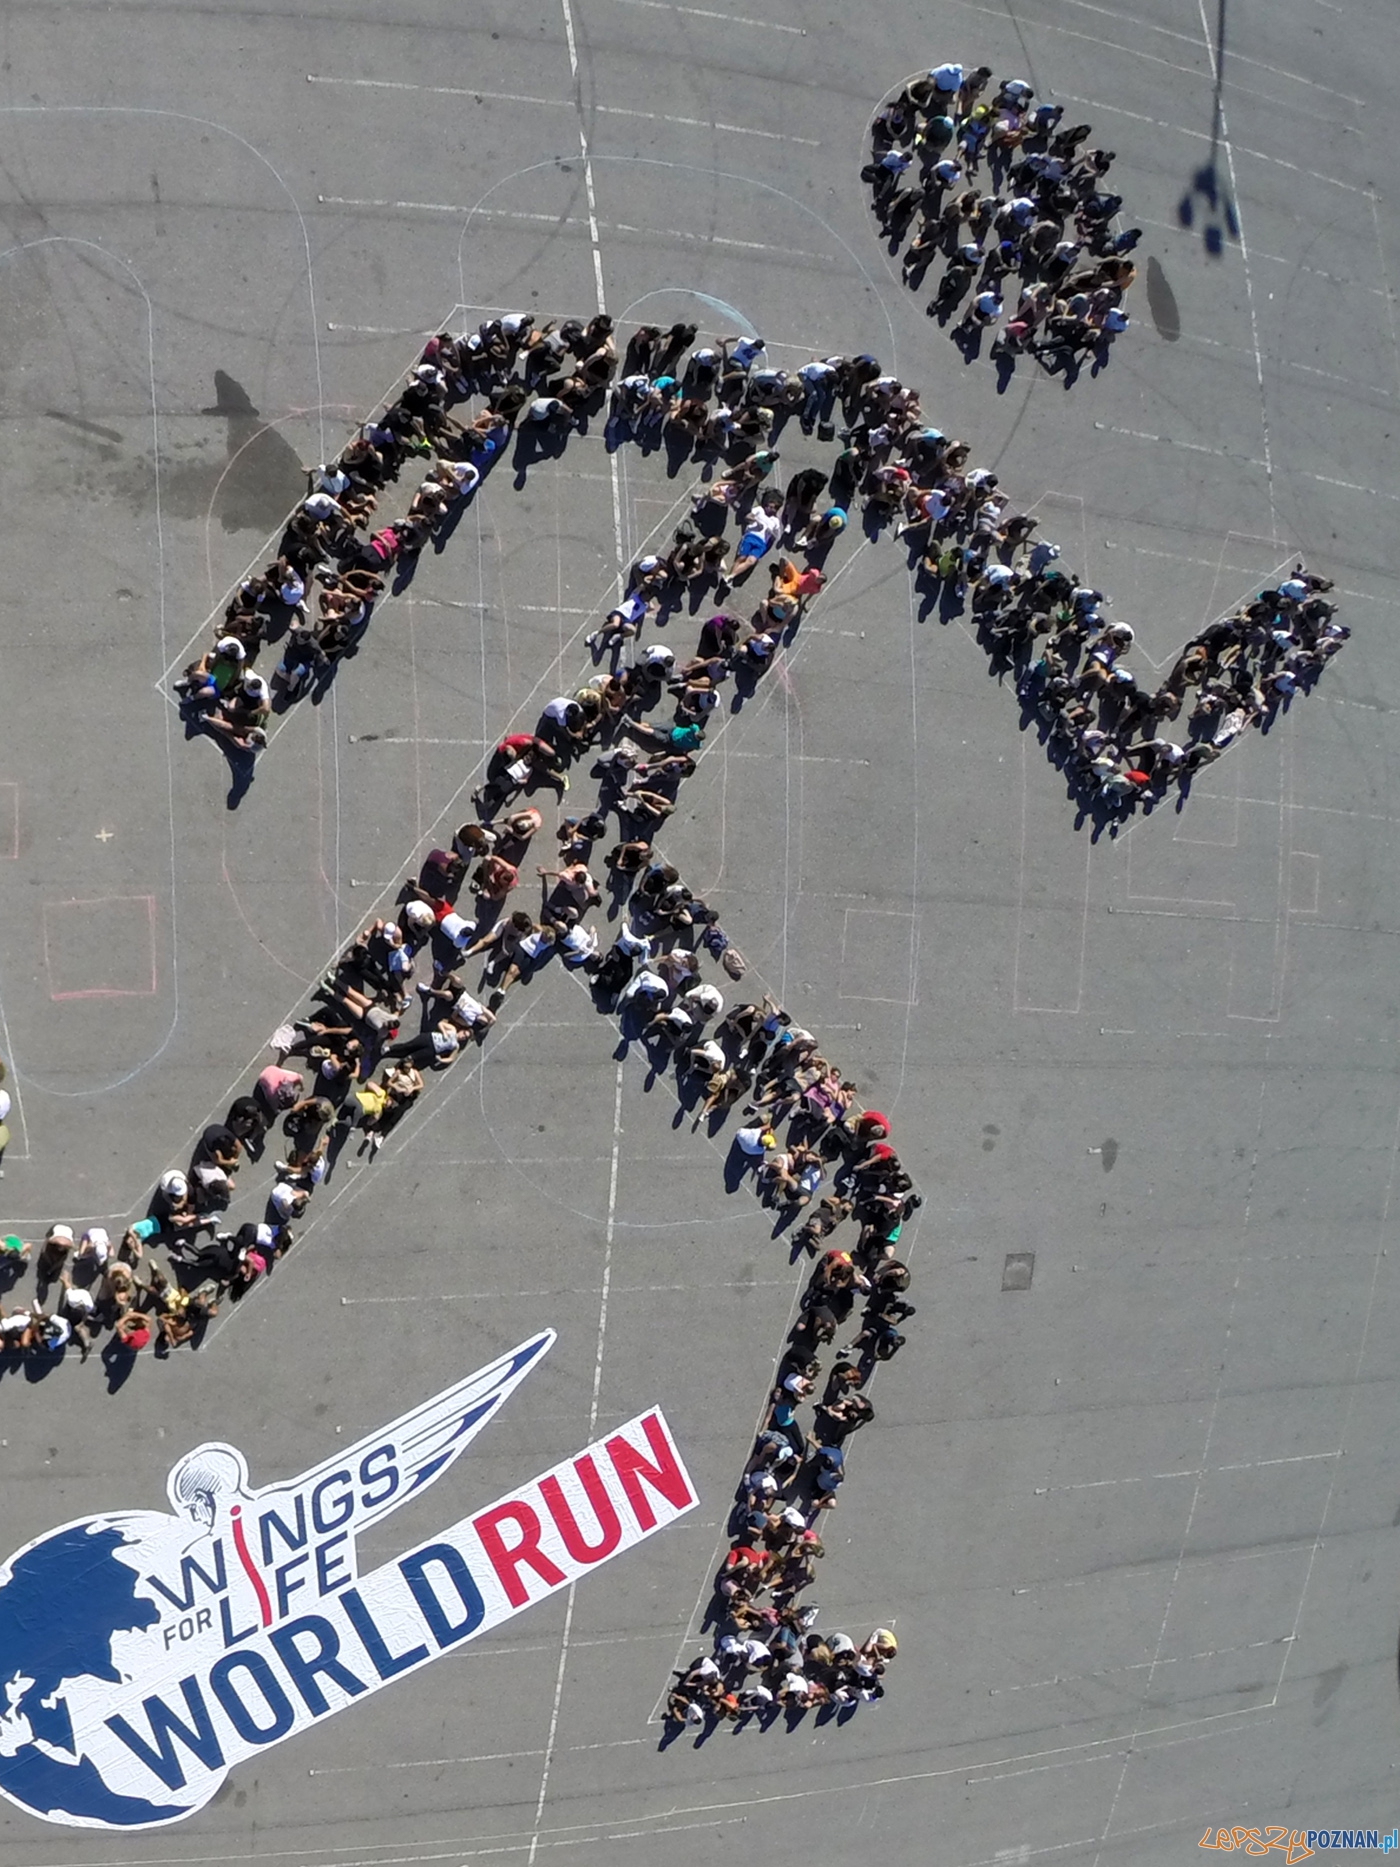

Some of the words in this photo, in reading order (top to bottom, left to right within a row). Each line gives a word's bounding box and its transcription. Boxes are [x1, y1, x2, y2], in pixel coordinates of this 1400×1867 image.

[105, 1543, 486, 1791] WORLD
[472, 1413, 693, 1609] RUN
[162, 1606, 213, 1651] FOR
